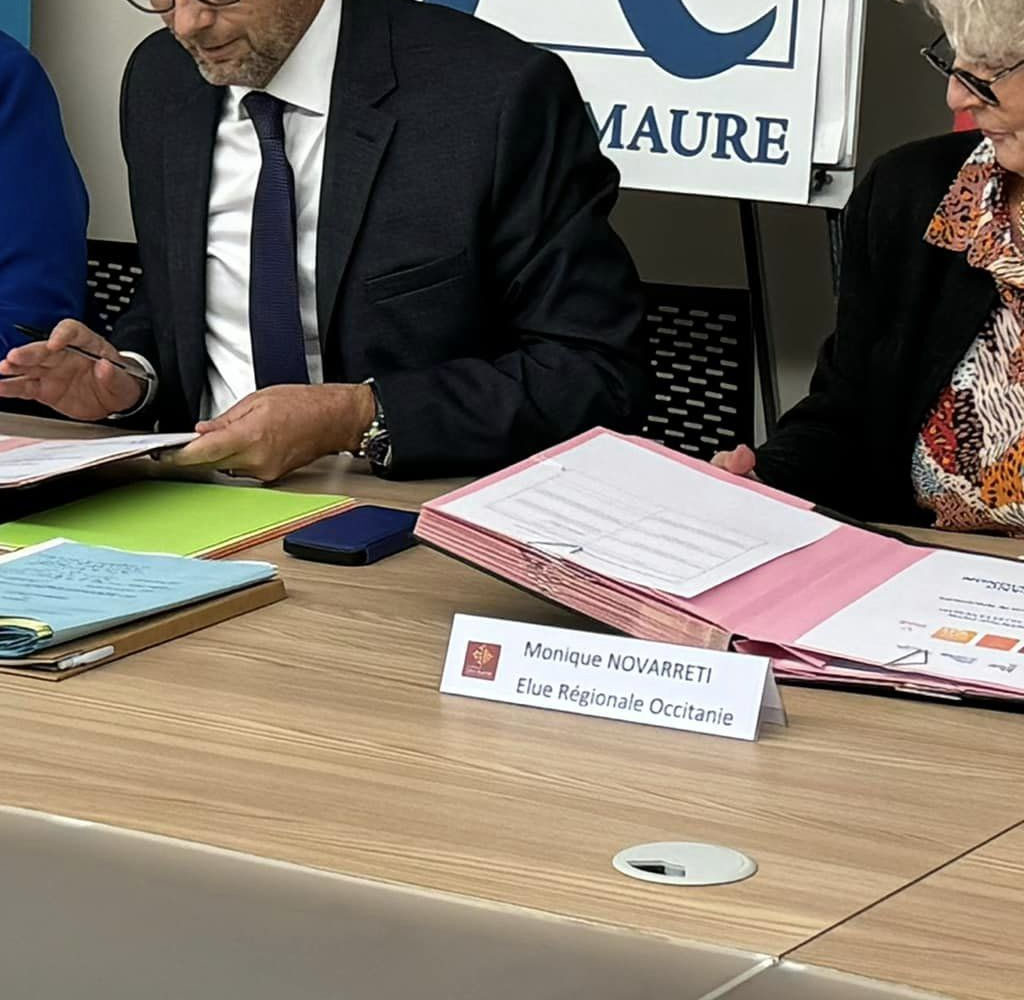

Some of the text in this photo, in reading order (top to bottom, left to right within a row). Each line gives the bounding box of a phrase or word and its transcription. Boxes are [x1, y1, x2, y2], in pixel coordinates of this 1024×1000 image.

[584, 102, 789, 165] MAURE
[524, 641, 712, 684] Monique NOVARRETI
[516, 677, 735, 727] Elue Régionale Occitanie
